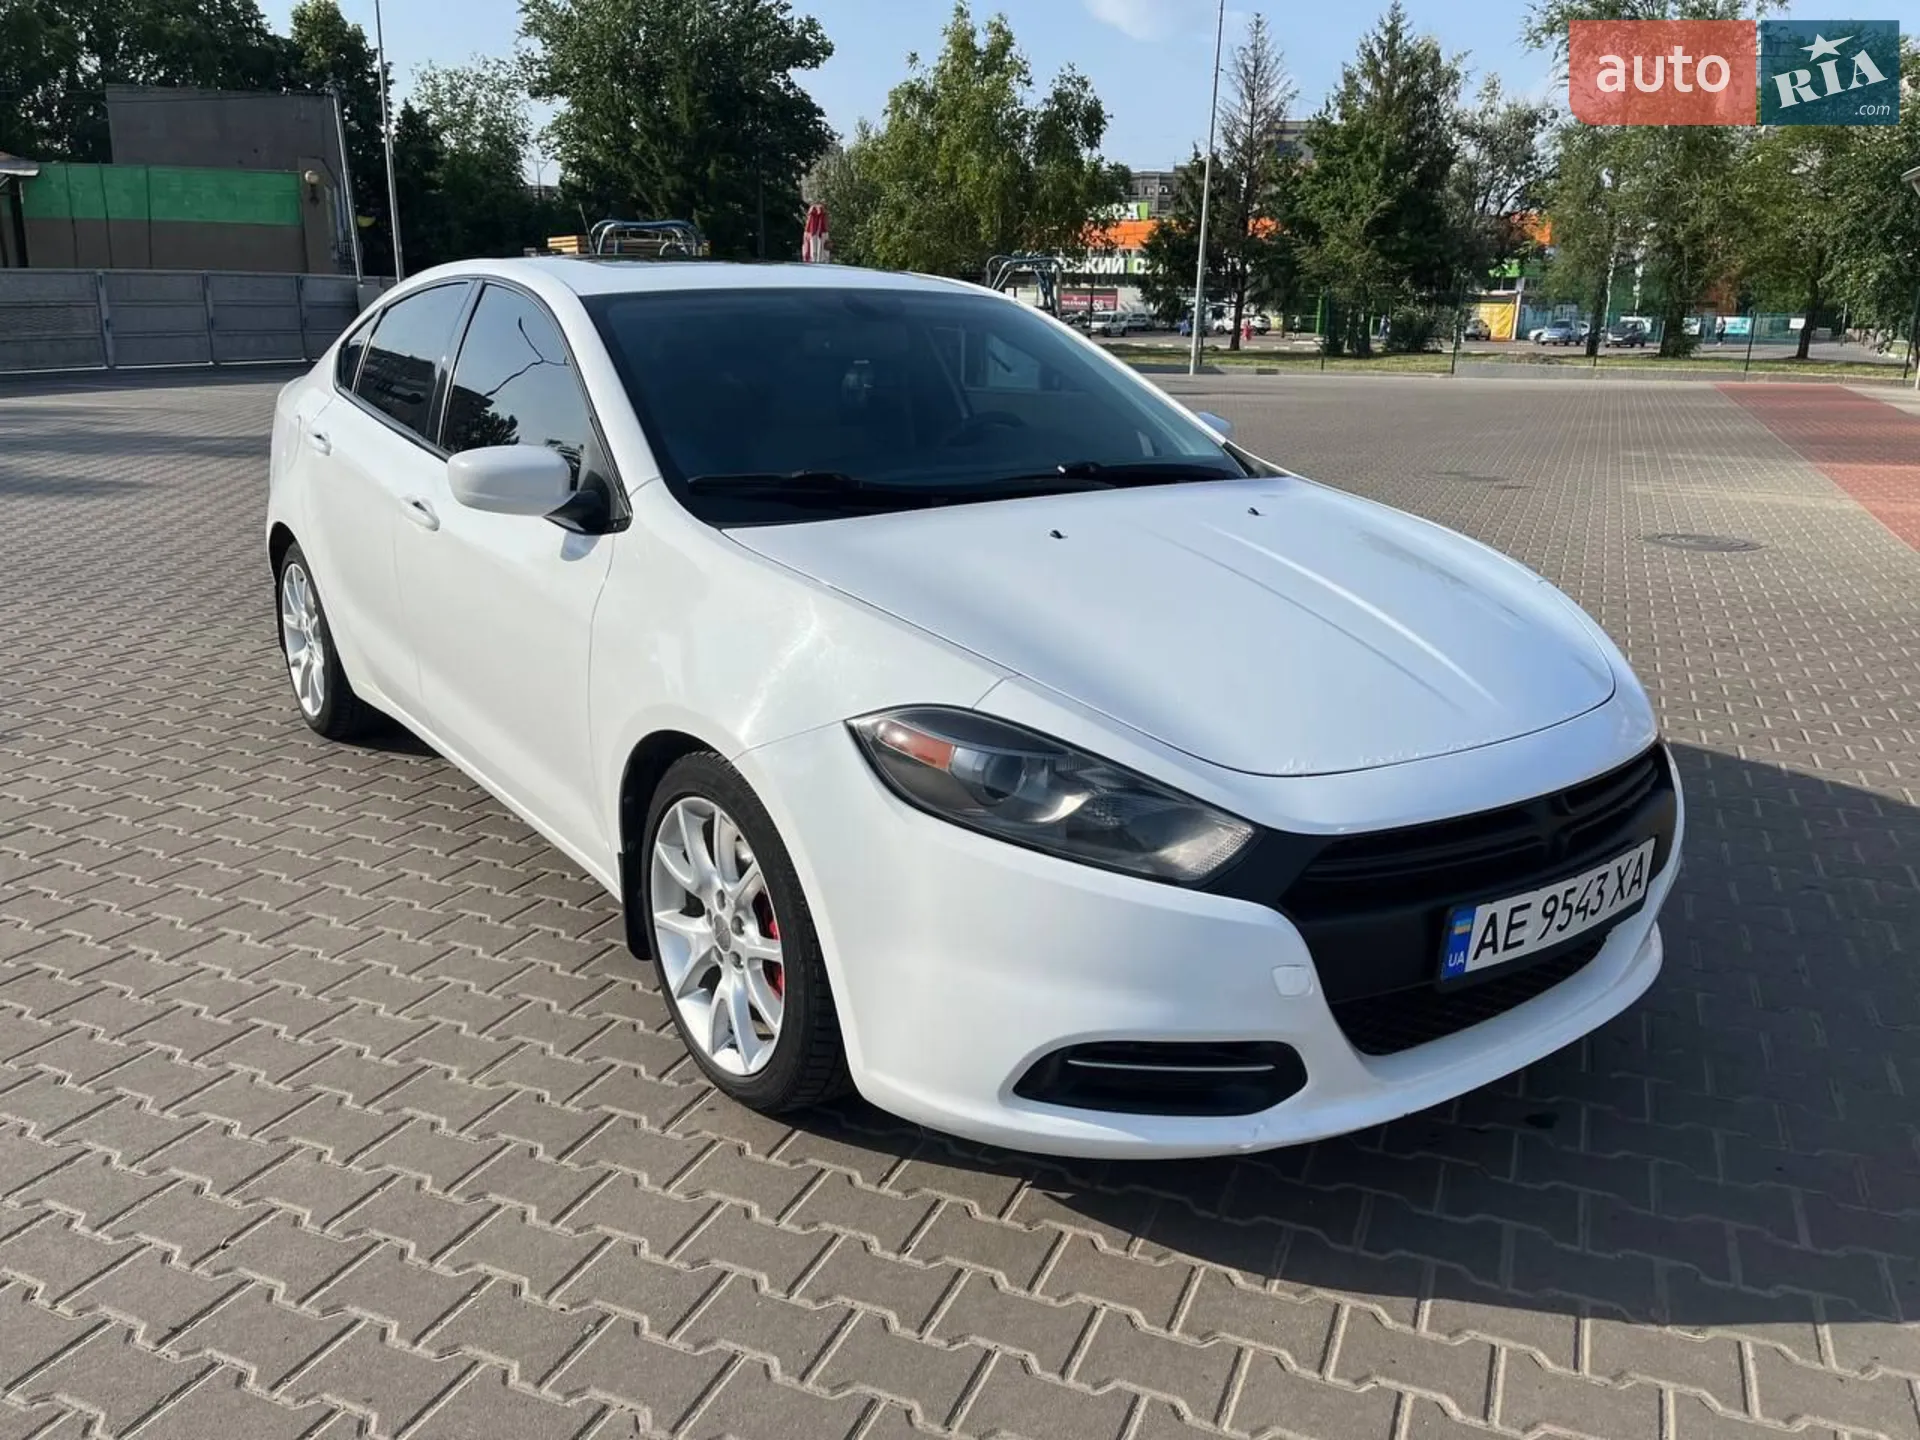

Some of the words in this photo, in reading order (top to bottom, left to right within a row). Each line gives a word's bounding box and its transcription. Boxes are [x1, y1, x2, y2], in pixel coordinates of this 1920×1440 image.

[1473, 902, 1531, 961] AE
[1537, 872, 1610, 940] 9543
[1609, 851, 1645, 908] XA
[1448, 950, 1465, 967] UA
